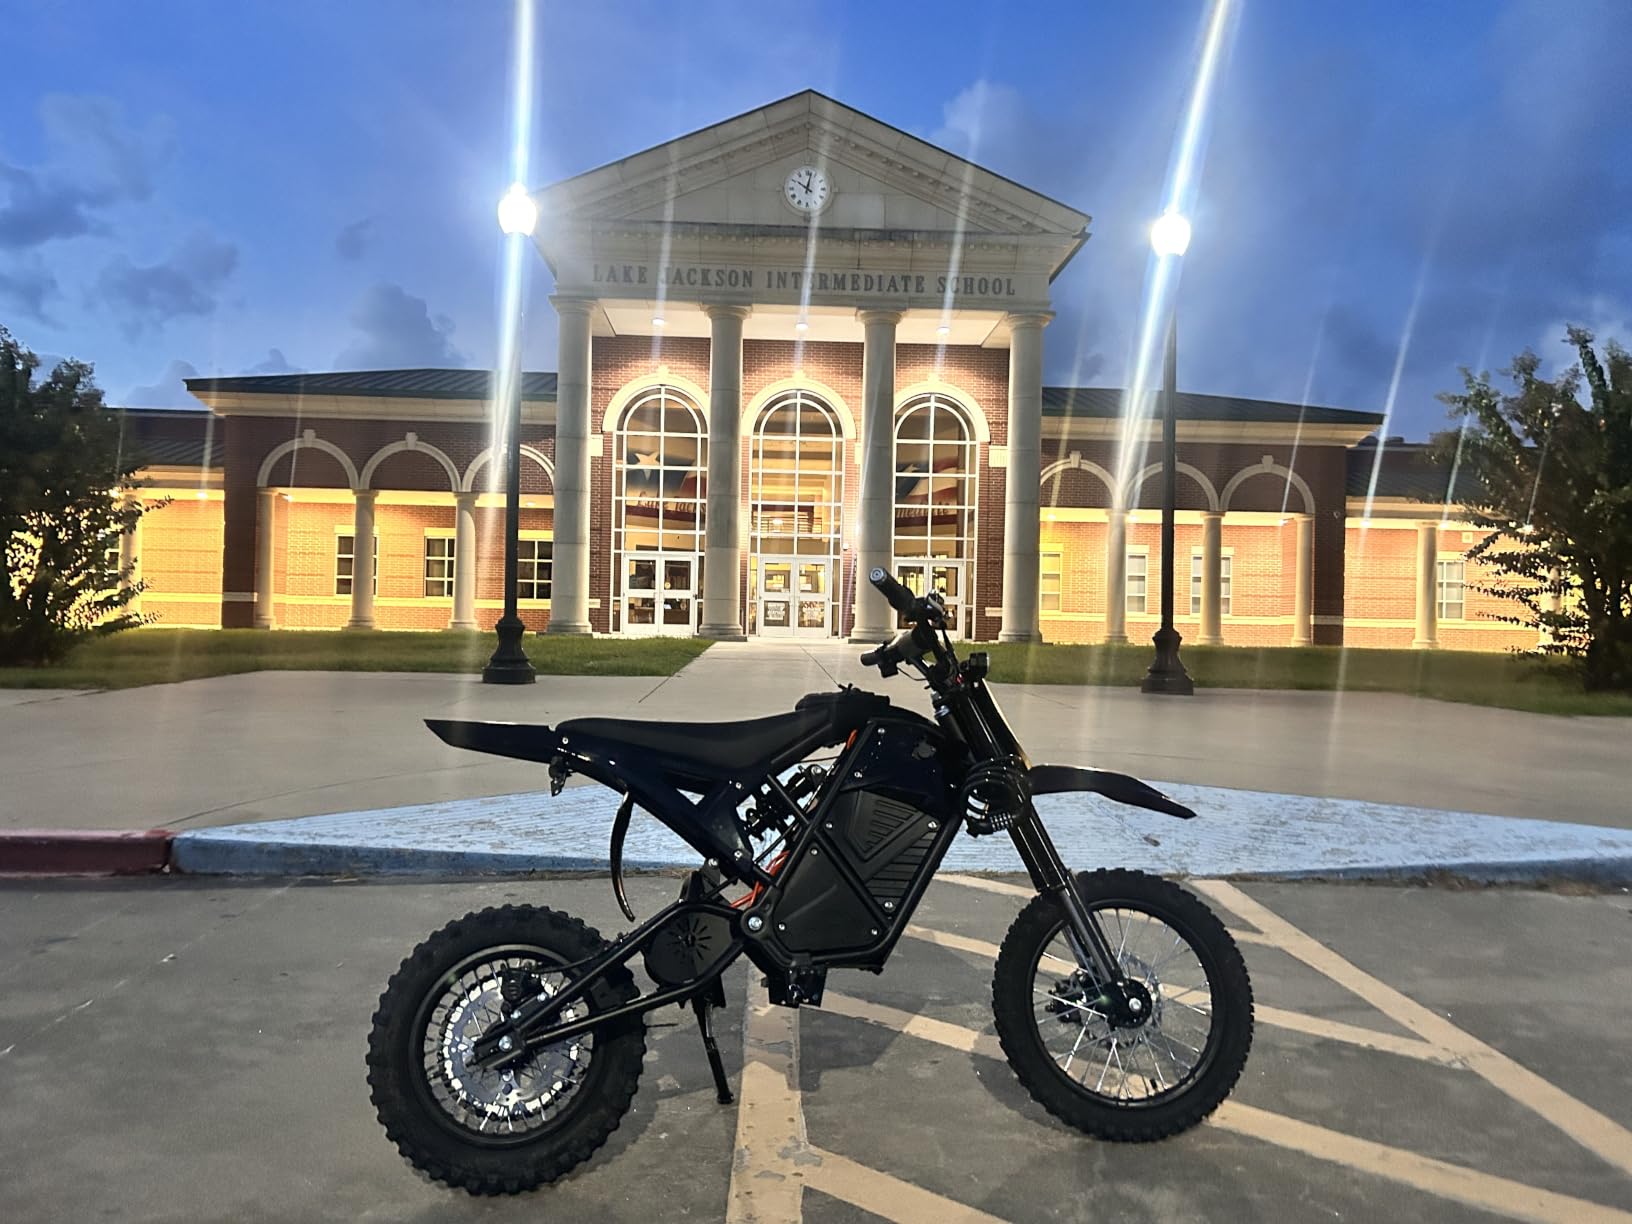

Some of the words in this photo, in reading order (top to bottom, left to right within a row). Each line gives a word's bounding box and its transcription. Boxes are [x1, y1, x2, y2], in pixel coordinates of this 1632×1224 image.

[593, 264, 648, 284] LAKE
[662, 266, 753, 288] JACKSON
[936, 276, 1016, 296] SCHOOL
